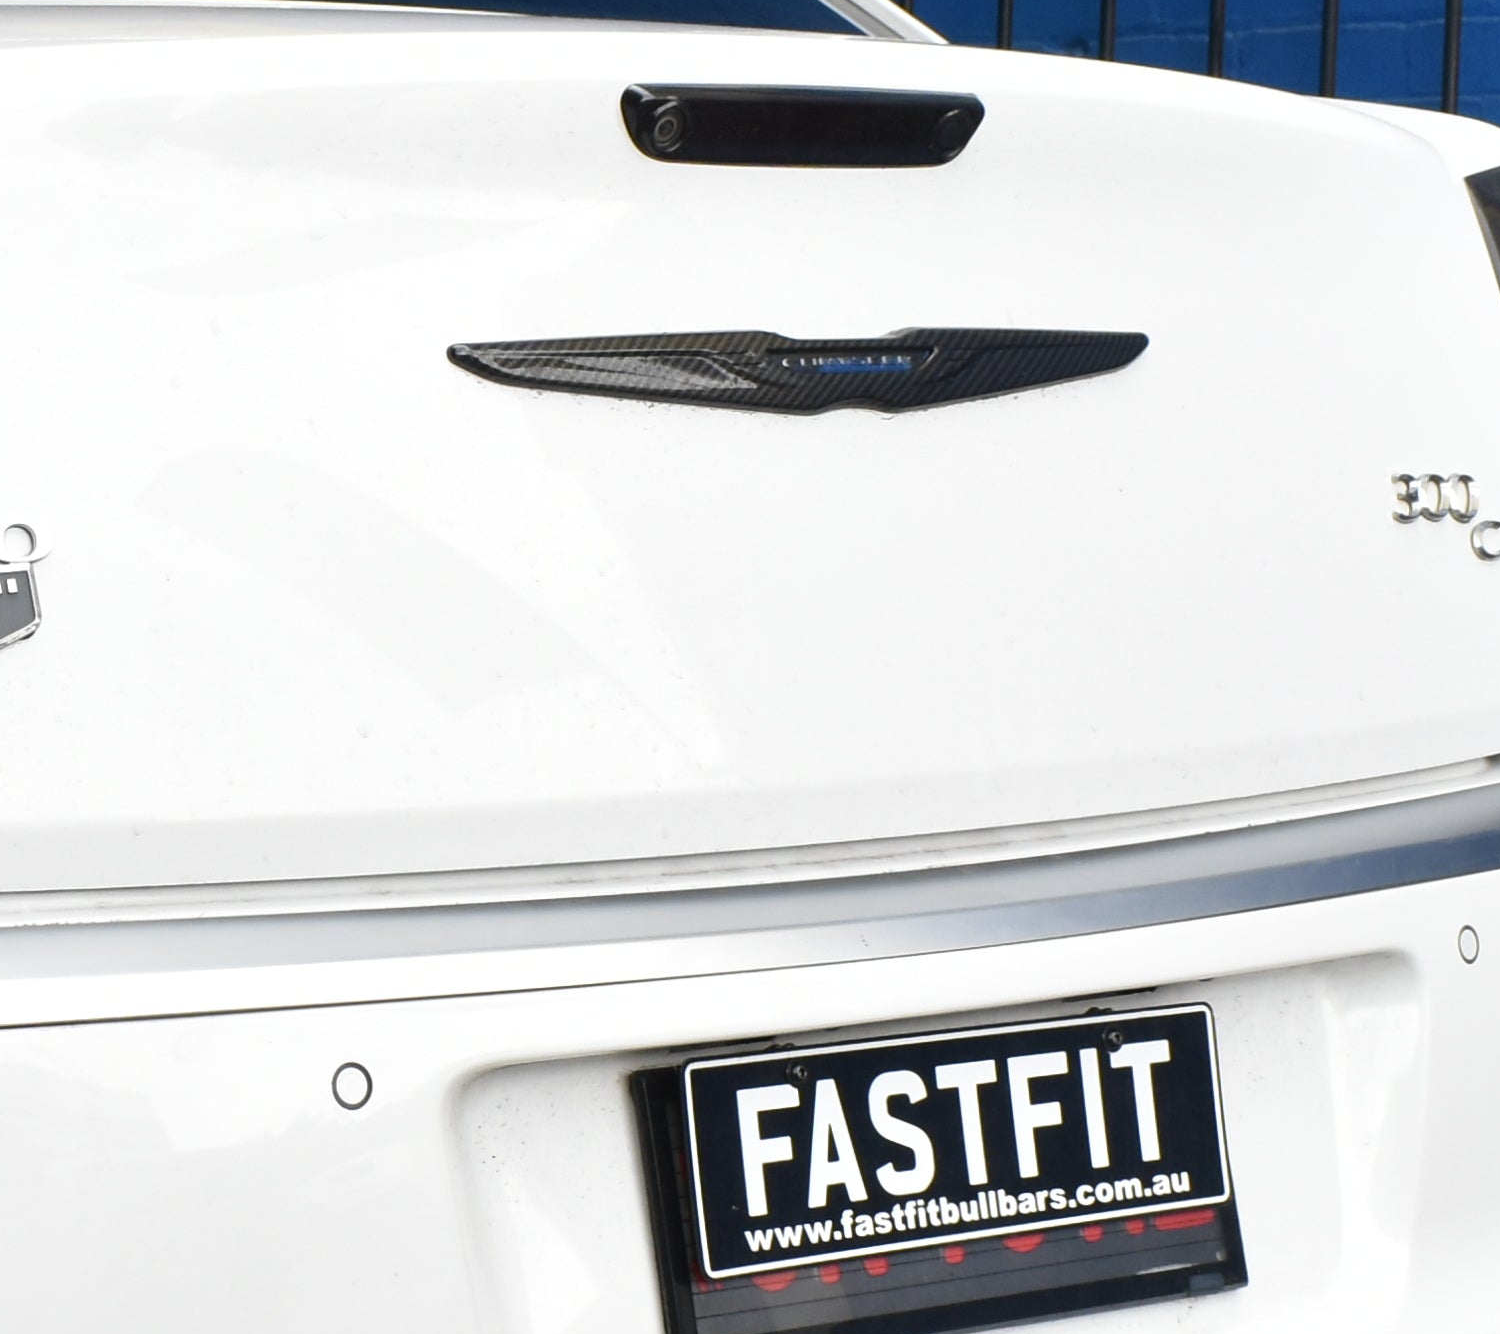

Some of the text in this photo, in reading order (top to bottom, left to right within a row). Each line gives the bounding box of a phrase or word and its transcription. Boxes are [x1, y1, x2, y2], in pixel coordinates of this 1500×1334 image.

[1391, 473, 1480, 524] 300
[735, 1038, 1171, 1217] FASTFIT
[744, 1170, 1190, 1253] www.fastfitbullbars.com.au
